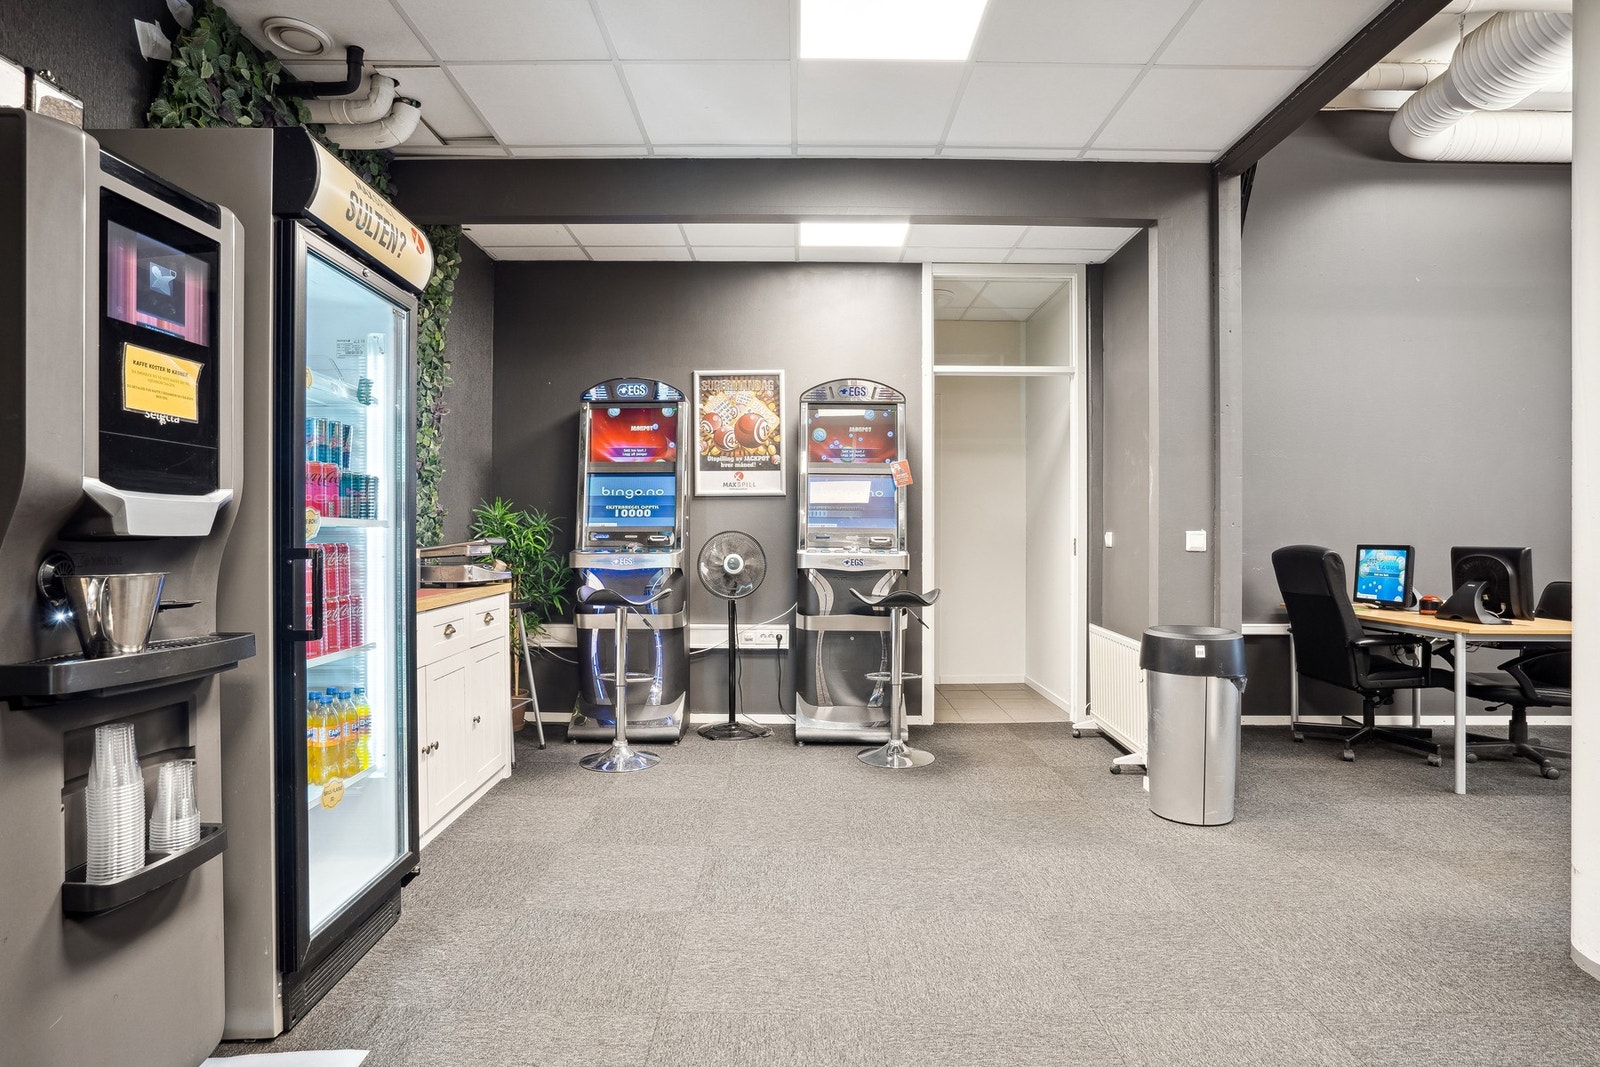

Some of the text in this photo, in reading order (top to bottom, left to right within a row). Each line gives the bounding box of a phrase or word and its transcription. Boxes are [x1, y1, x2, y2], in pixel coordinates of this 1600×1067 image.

[345, 190, 407, 259] SULTEN?
[132, 359, 148, 368] KAFFE
[148, 363, 166, 372] KOSTER
[628, 385, 646, 395] EGS
[701, 379, 775, 392] SUPERMANDAG
[848, 386, 867, 396] EGS
[601, 486, 664, 499] bingo.no
[614, 509, 652, 517] 10000
[619, 558, 633, 566] EGS
[850, 559, 864, 567] EGS
